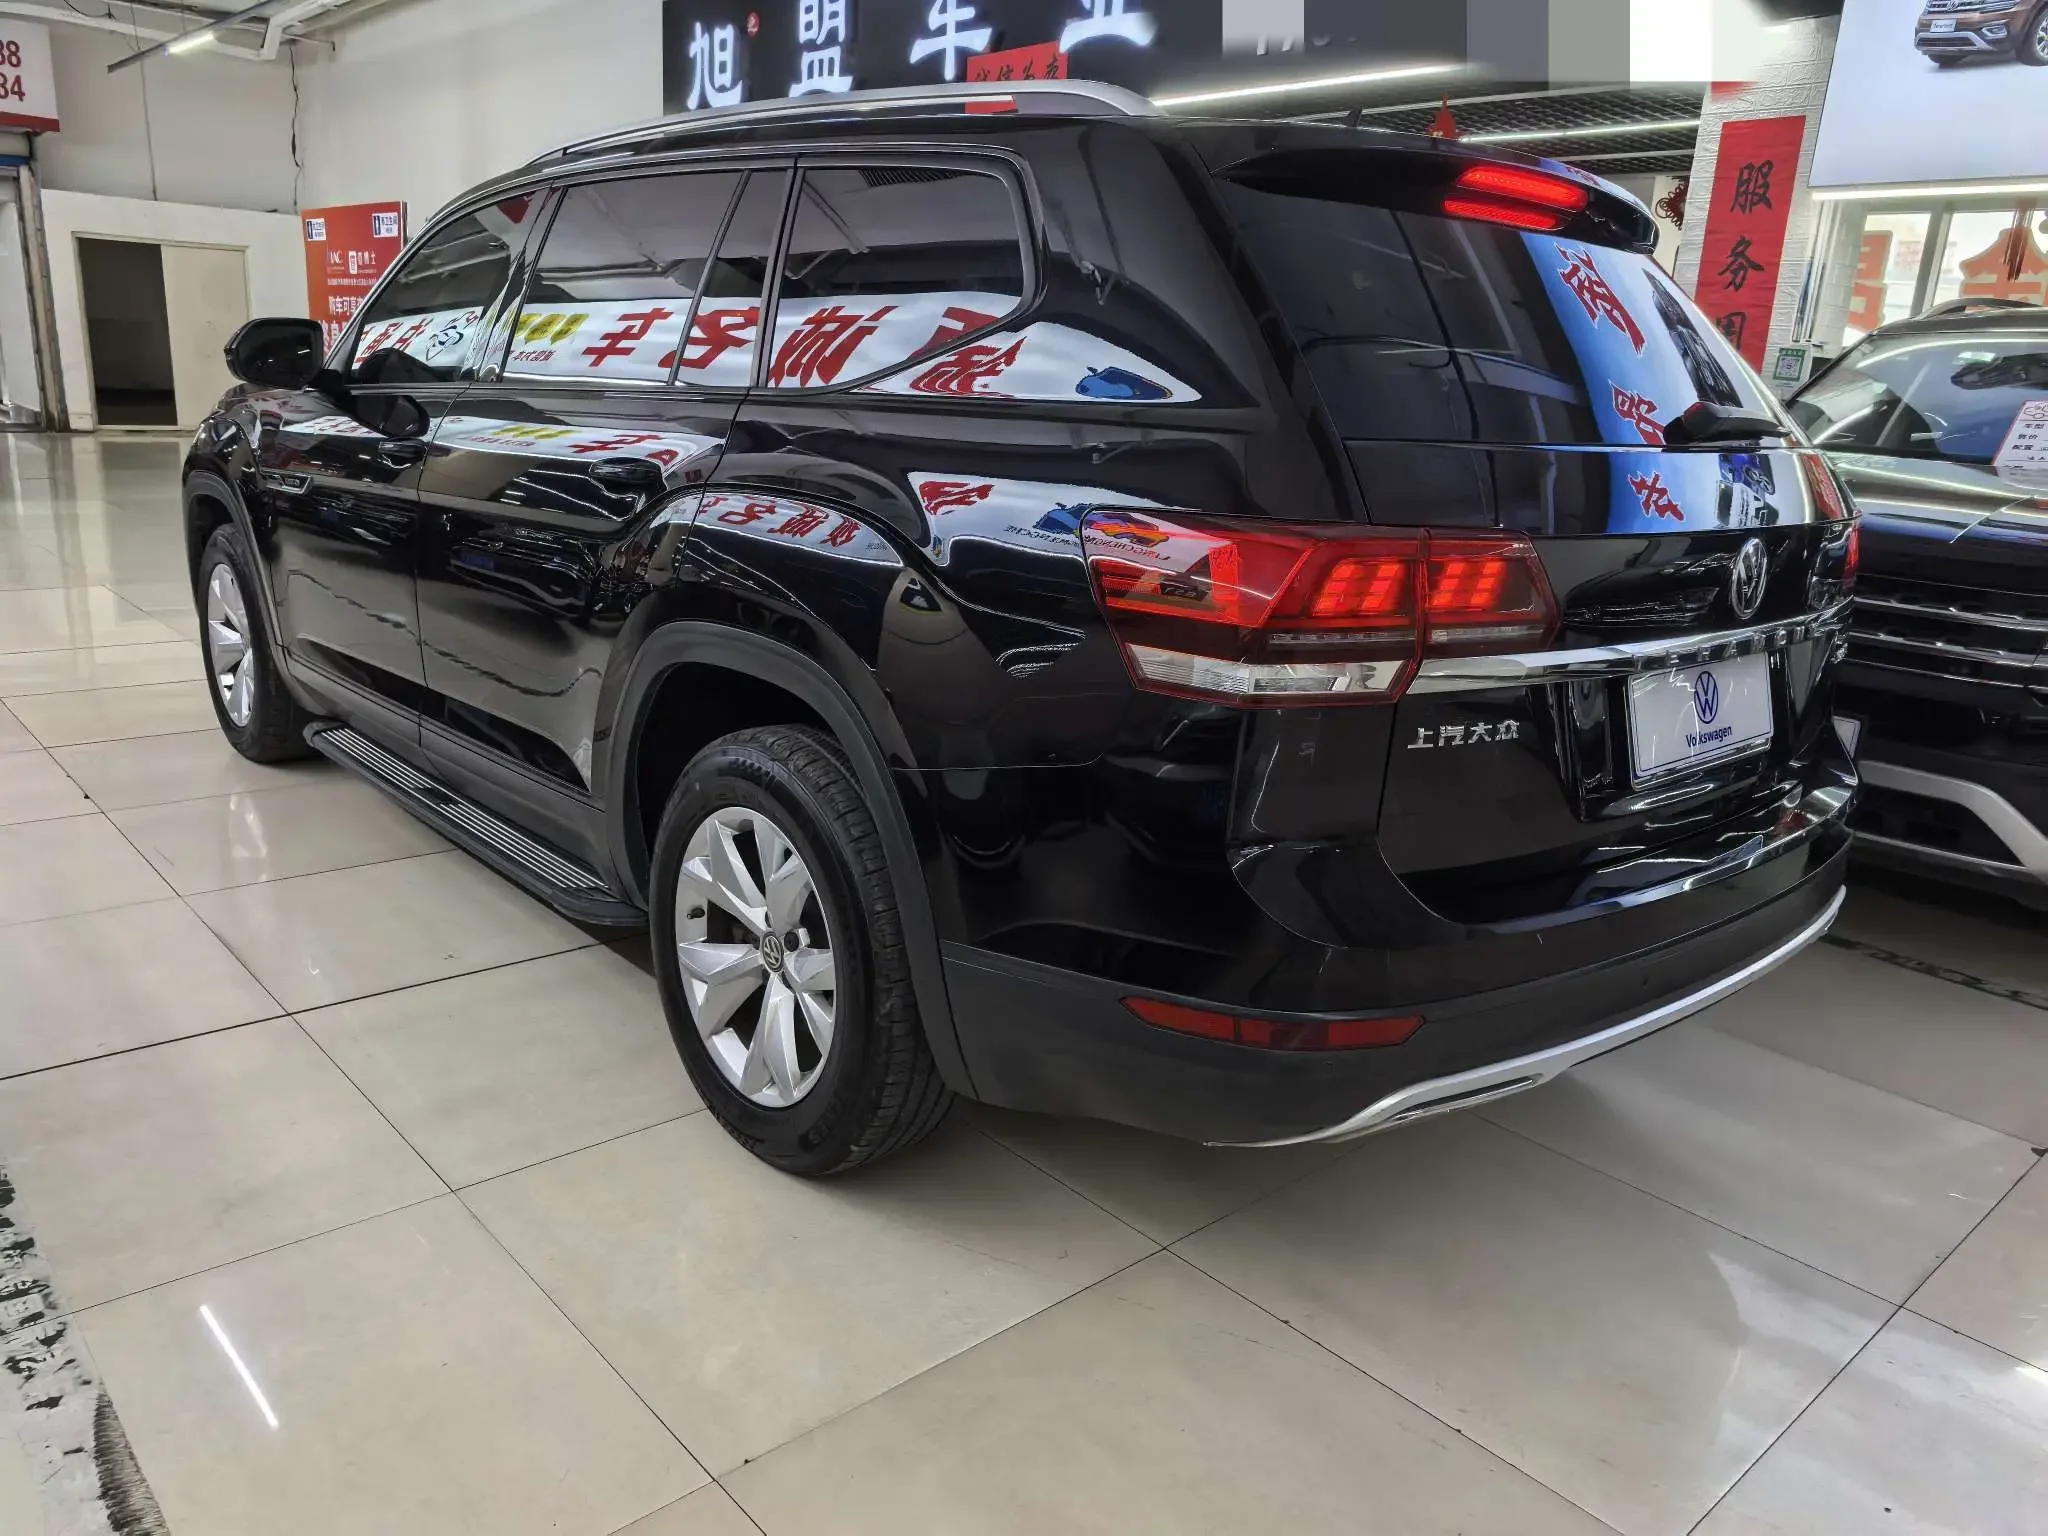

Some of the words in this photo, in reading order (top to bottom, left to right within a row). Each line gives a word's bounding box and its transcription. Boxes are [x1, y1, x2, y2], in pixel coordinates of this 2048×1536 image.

[1407, 719, 1520, 749] 上汽大众
[1686, 725, 1733, 748] Volkswagen
